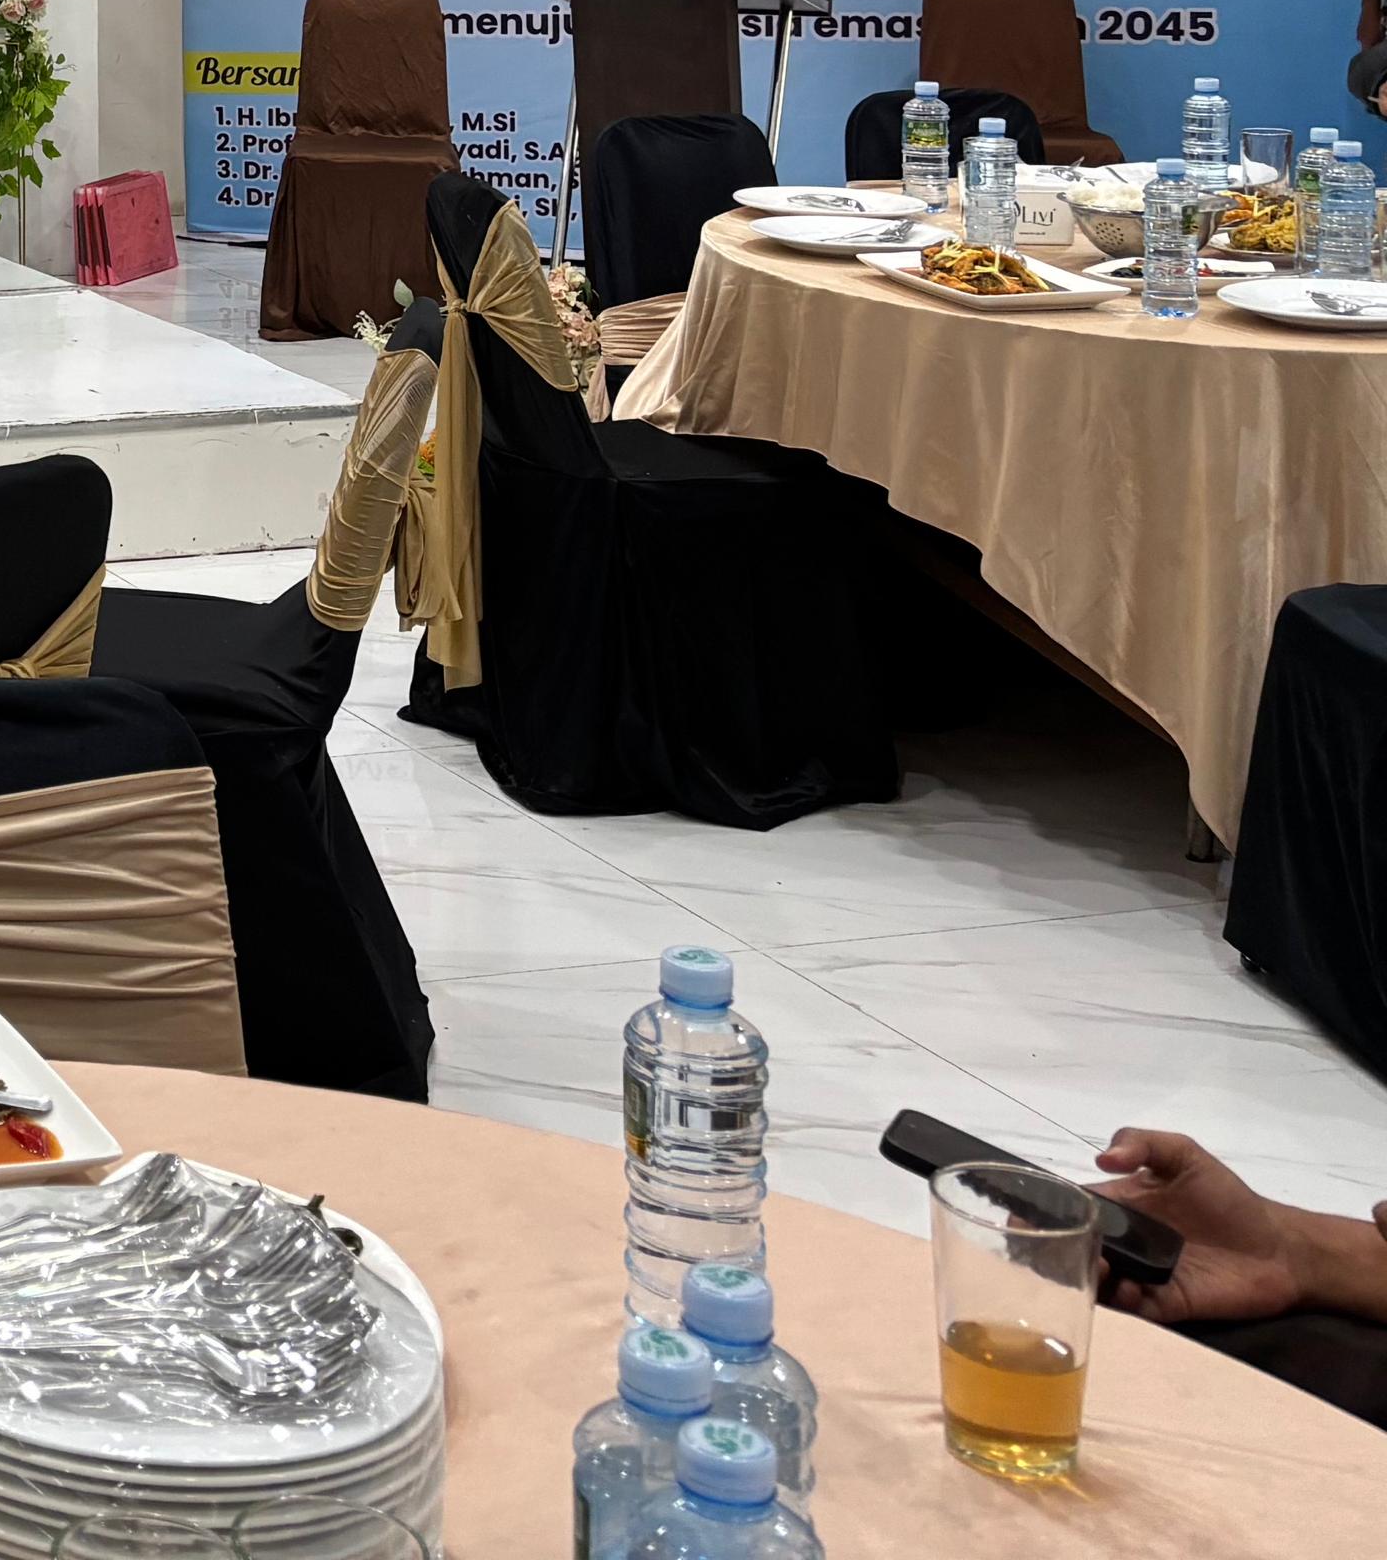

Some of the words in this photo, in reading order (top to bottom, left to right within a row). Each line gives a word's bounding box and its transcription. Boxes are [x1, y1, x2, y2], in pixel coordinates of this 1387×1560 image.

[1098, 11, 1215, 42] 2045
[215, 107, 231, 126] 1.
[238, 108, 261, 126] H.
[462, 111, 516, 132] M.Si
[216, 133, 237, 152] 2.
[217, 160, 238, 179] 3.
[244, 161, 279, 180] Dr.
[218, 187, 240, 206] 4.
